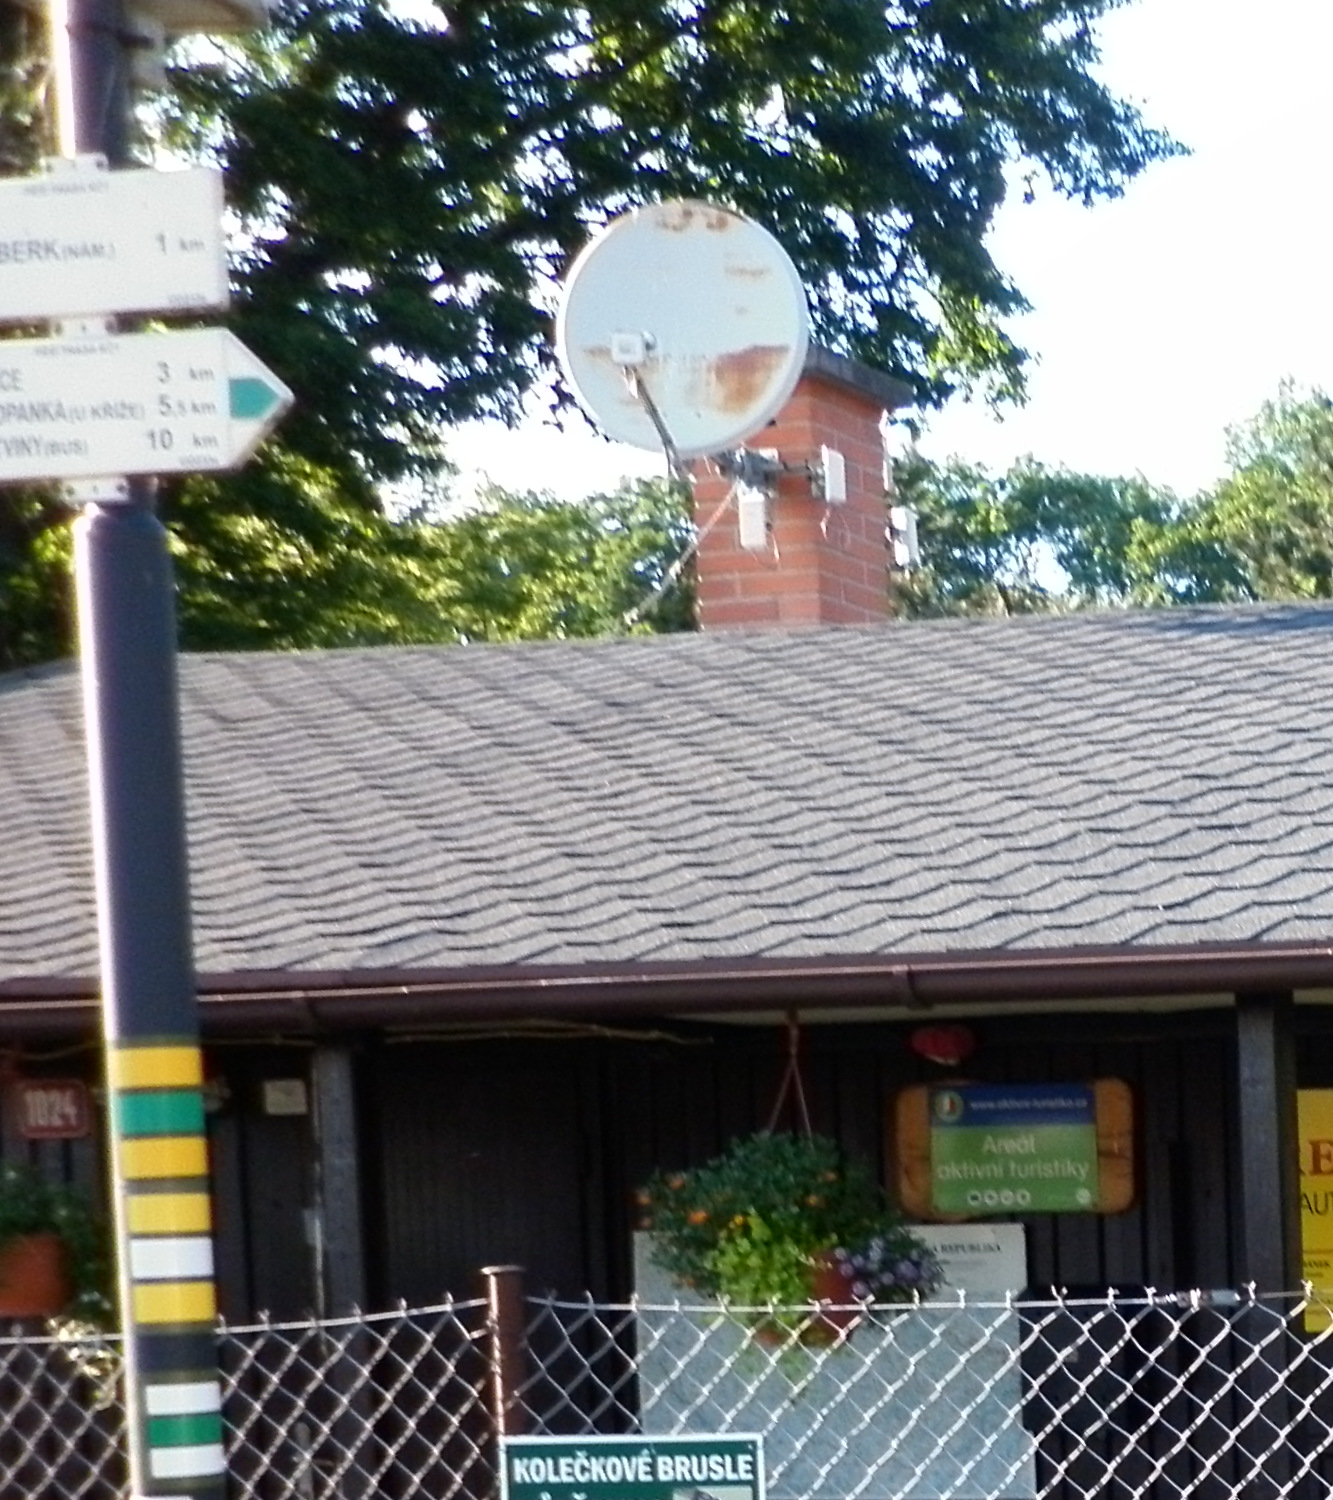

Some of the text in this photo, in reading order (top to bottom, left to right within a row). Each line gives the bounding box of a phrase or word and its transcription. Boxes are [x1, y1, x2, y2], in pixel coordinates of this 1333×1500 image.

[155, 231, 206, 255] 1 km
[156, 360, 215, 385] 3 km
[190, 400, 217, 416] km
[146, 427, 219, 451] 10 km
[1009, 1159, 1090, 1181] turistiky
[513, 1449, 754, 1483] KOLEČKOVÉ BRUSLE
